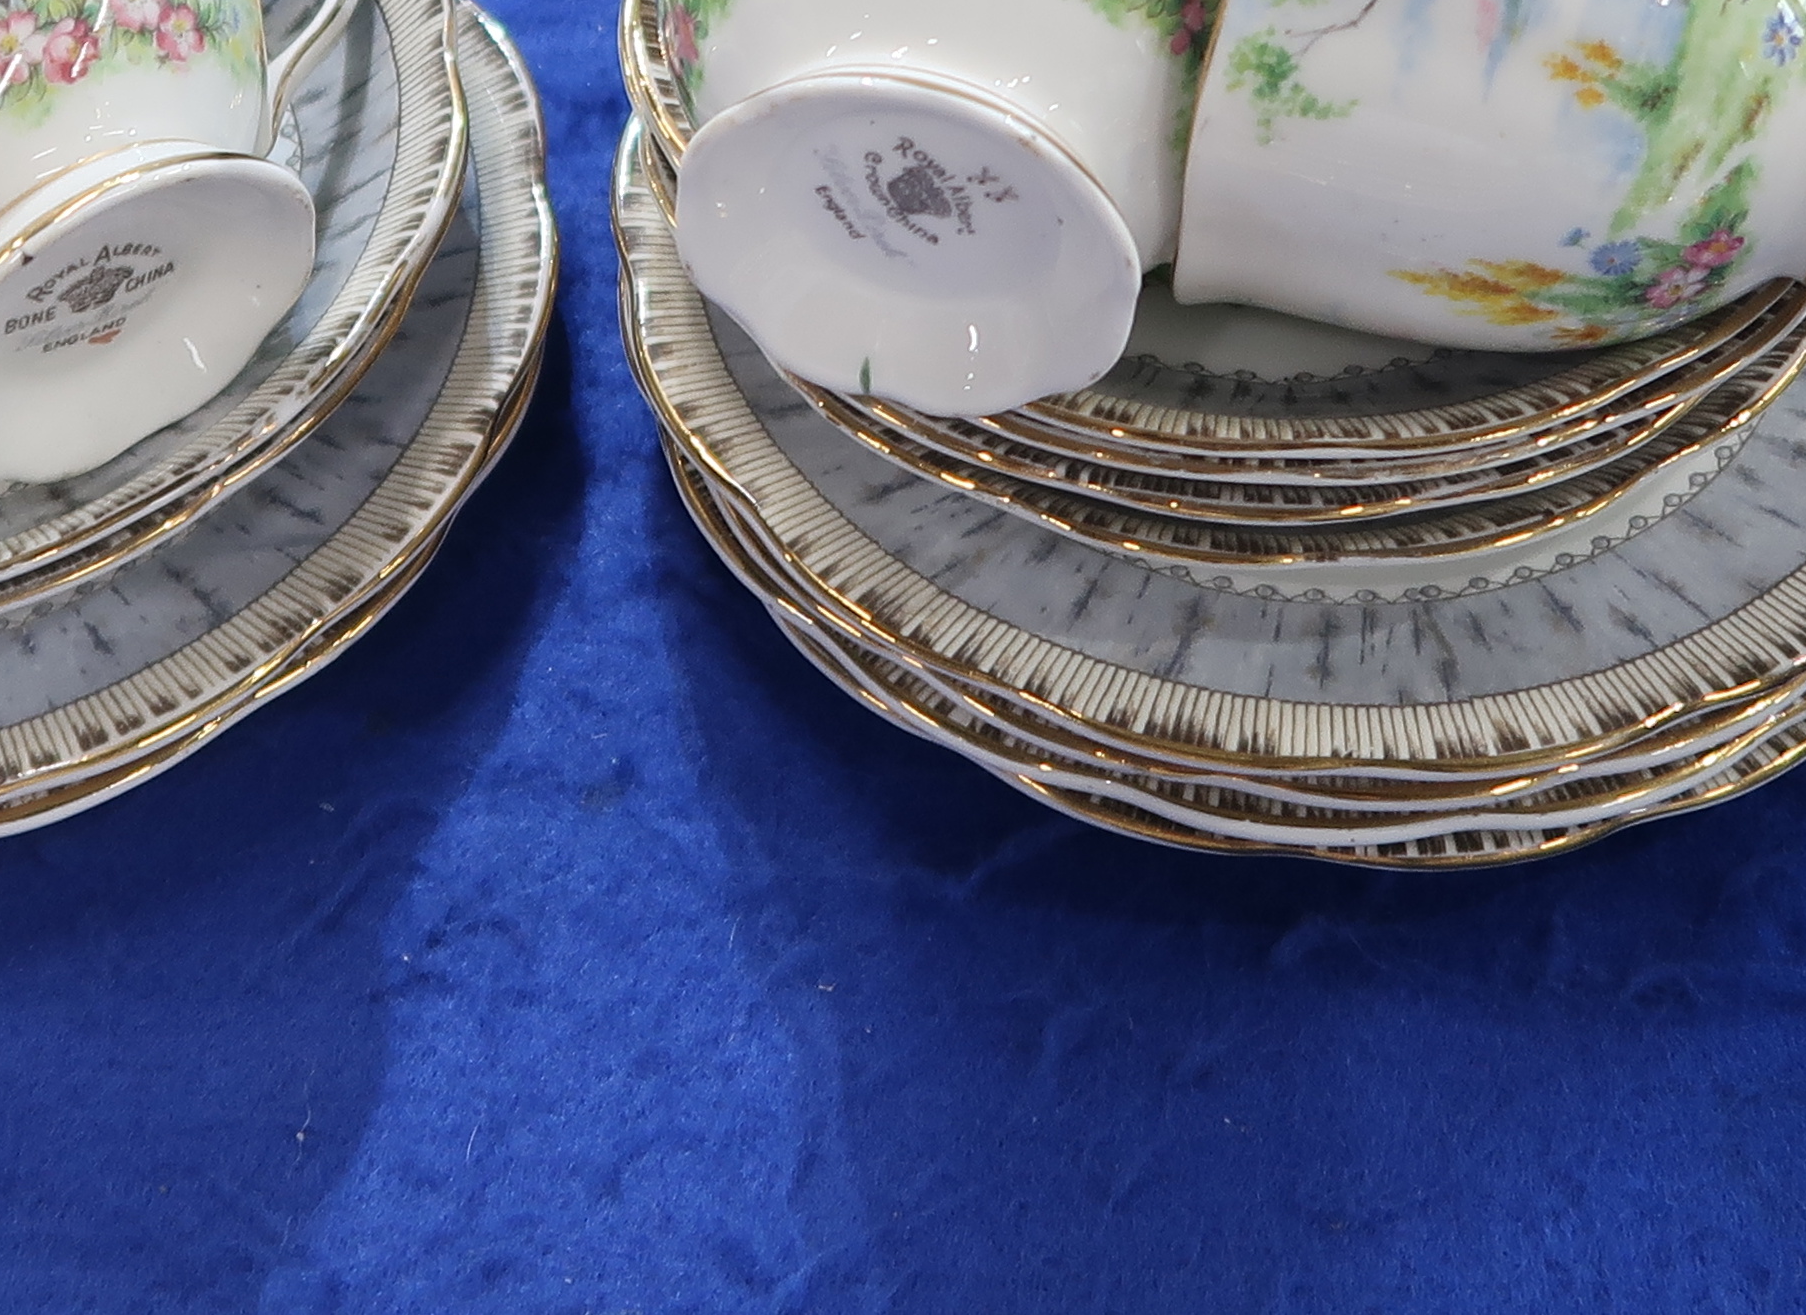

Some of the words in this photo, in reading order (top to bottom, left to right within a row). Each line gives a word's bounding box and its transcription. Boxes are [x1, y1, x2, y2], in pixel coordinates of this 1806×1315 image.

[892, 136, 956, 184] Royal
[3, 306, 58, 335] BONE
[123, 260, 176, 294] CHINA
[25, 257, 90, 304] ROYAL
[93, 242, 163, 267] ALBERT
[41, 316, 128, 354] ENGLAND
